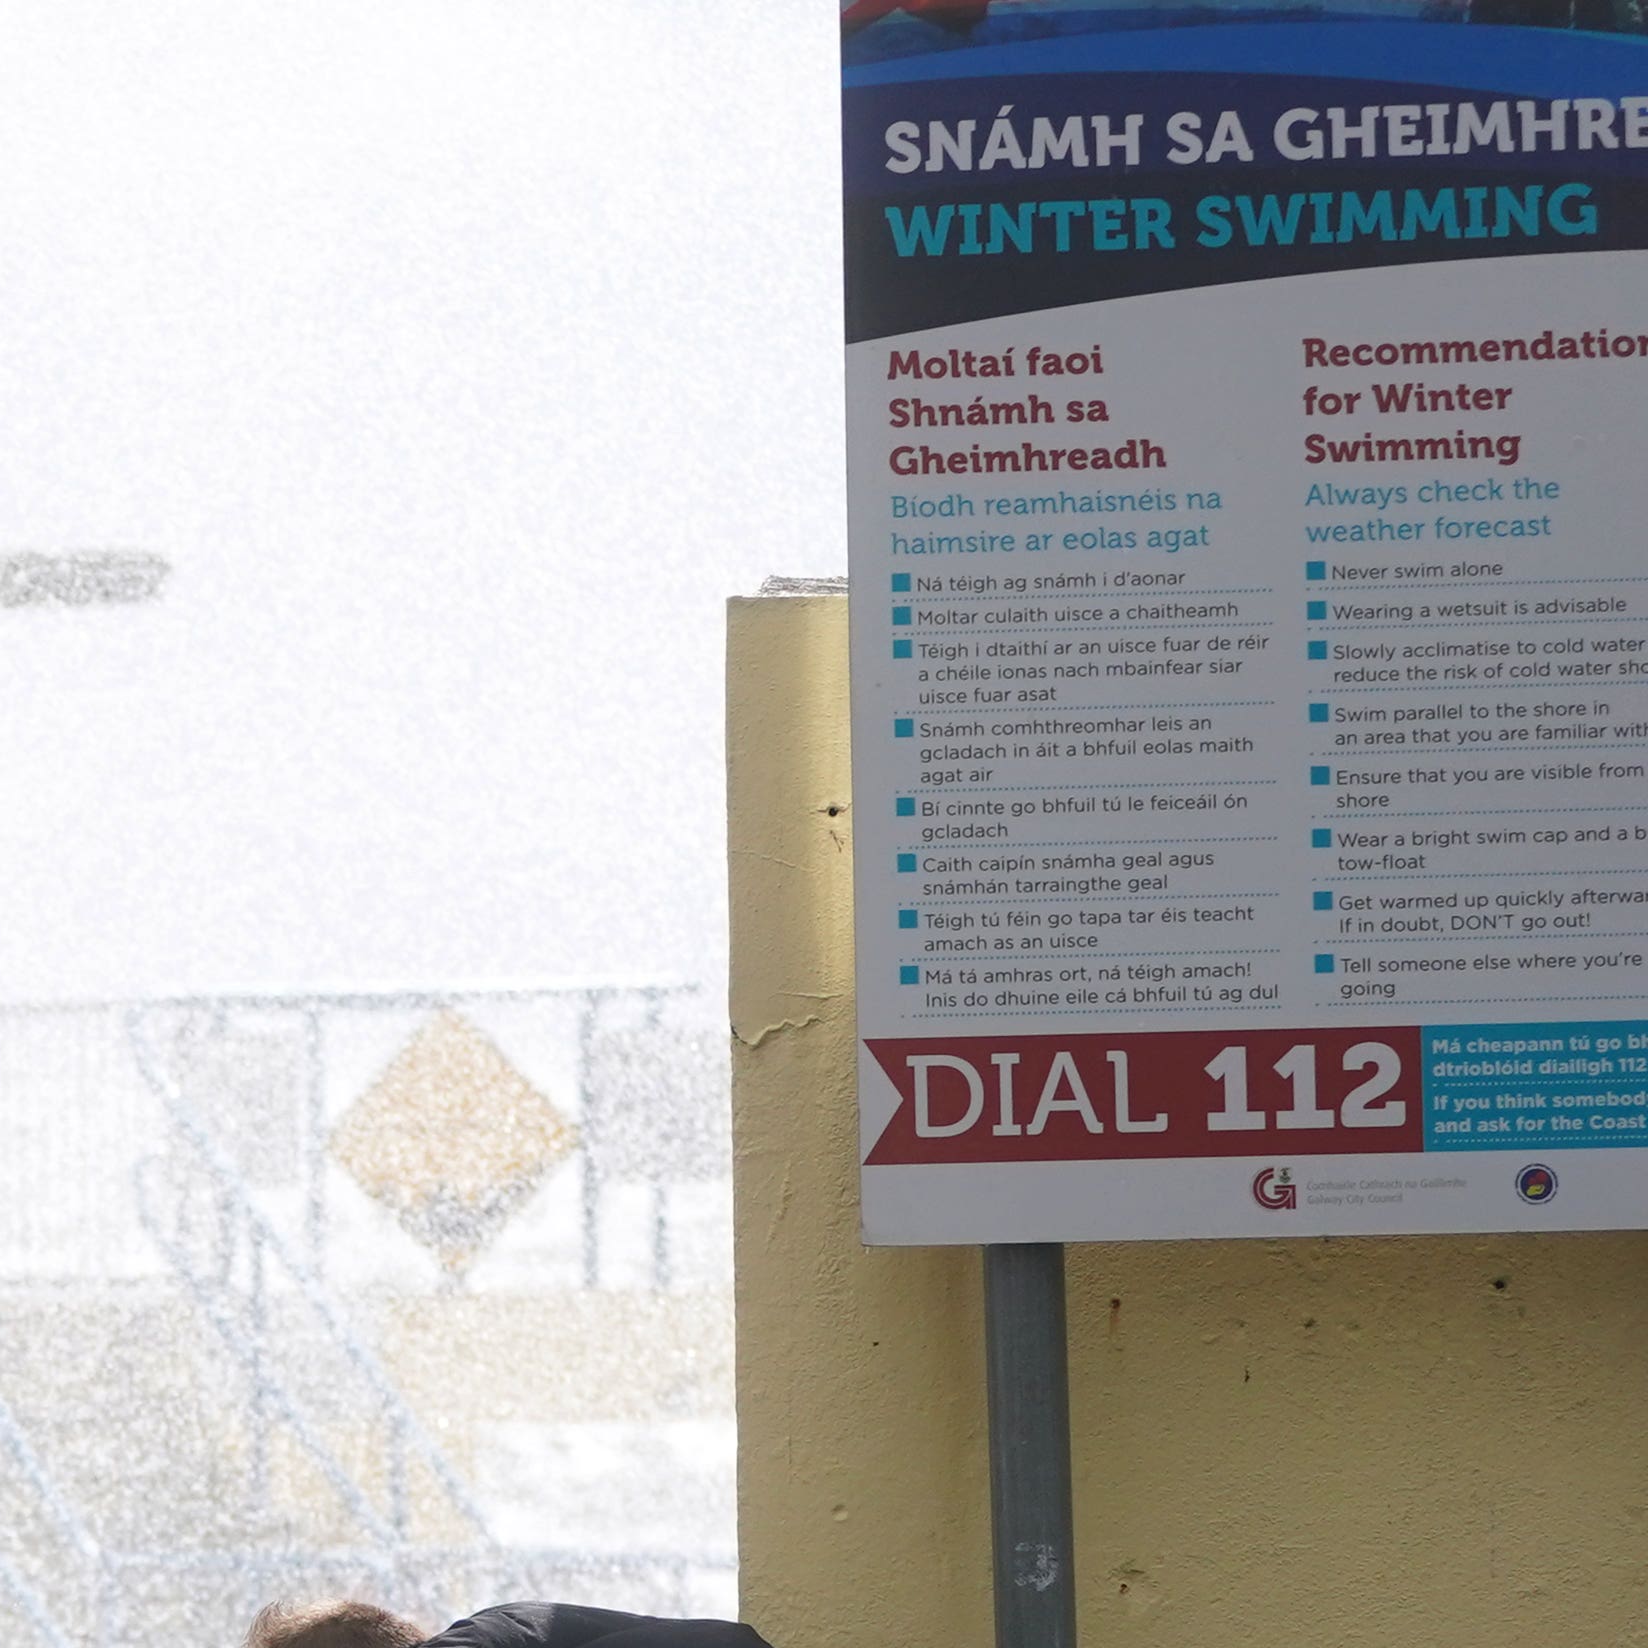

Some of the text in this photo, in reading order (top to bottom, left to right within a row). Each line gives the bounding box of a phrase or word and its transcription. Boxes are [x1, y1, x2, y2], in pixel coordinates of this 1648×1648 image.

[885, 105, 1143, 174] SNÁMH
[1166, 111, 1254, 164] SA
[886, 184, 1597, 256] WINTER SWIMMING
[887, 345, 1103, 380] Moltaí faoi
[1303, 383, 1512, 415] for Winter
[889, 394, 1109, 428] Shnámh sa
[889, 439, 1167, 475] Gheimhreadh
[1305, 430, 1521, 466] Swimming
[891, 489, 1223, 518] Bíodh reamhaisnéis na
[1305, 477, 1560, 510] Always check the
[892, 525, 1210, 554] haimsire ar eolas agat
[1305, 516, 1551, 543] weather forecast
[1332, 561, 1503, 580] Never swim alone
[917, 571, 1186, 596] Ná téigh ag snámh i d'aonar
[918, 602, 1238, 625] Moltar culaith uisce a chaitheamh
[1332, 597, 1627, 621] Wearing a wetsuit is advisable
[919, 687, 1056, 704] uisce fuar asat
[1335, 700, 1609, 723] Swim parallel to the shore in
[920, 716, 1211, 738] Snámh comhthreomhar leis an
[1335, 733, 1357, 745] an
[1364, 732, 1405, 745] area
[1412, 728, 1450, 743] that
[1457, 730, 1492, 745] you
[1498, 728, 1529, 741] are
[1535, 723, 1608, 740] familiar
[920, 737, 1253, 763] gcladach in áit a bhfuil eolas maith
[921, 767, 993, 785] agat air
[923, 851, 1214, 873] Caith caipín snámha geal agus
[923, 874, 1167, 896] snámhán tarraingthe geal
[1339, 895, 1372, 910] Get
[1379, 893, 1457, 909] warmed
[1464, 895, 1489, 909] up
[1495, 890, 1564, 909] quickly
[1340, 912, 1590, 933] If in doubt, DON'T go out!
[1432, 1038, 1461, 1054] Má
[1466, 1038, 1564, 1055] cheapann
[1569, 1035, 1590, 1051] tú
[1596, 1038, 1622, 1053] go
[1432, 1060, 1533, 1077] dtrioblóid
[1538, 1058, 1613, 1076] diailigh
[906, 1042, 1406, 1138] DIAL 112
[1434, 1091, 1648, 1112] If you think somebod
[1434, 1114, 1647, 1133] and ask for the Coast
